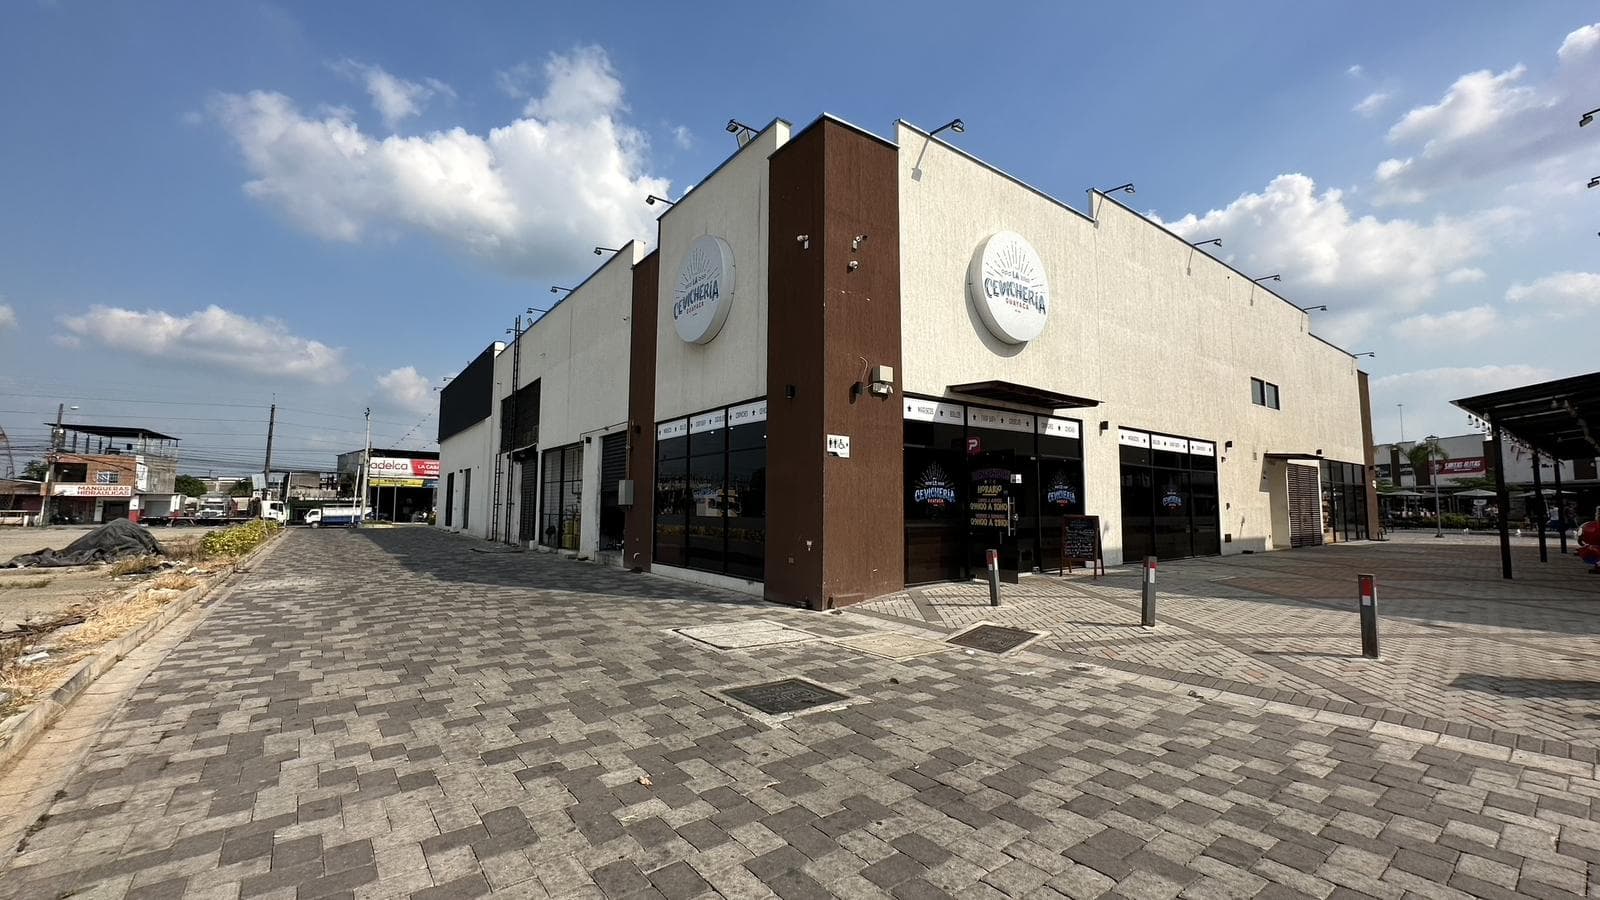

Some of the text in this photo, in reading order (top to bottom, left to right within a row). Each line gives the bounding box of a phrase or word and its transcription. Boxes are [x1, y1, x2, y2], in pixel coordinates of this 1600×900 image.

[1012, 271, 1020, 280] LA
[1005, 297, 1029, 310] GUAYACA
[370, 459, 408, 470] adelca
